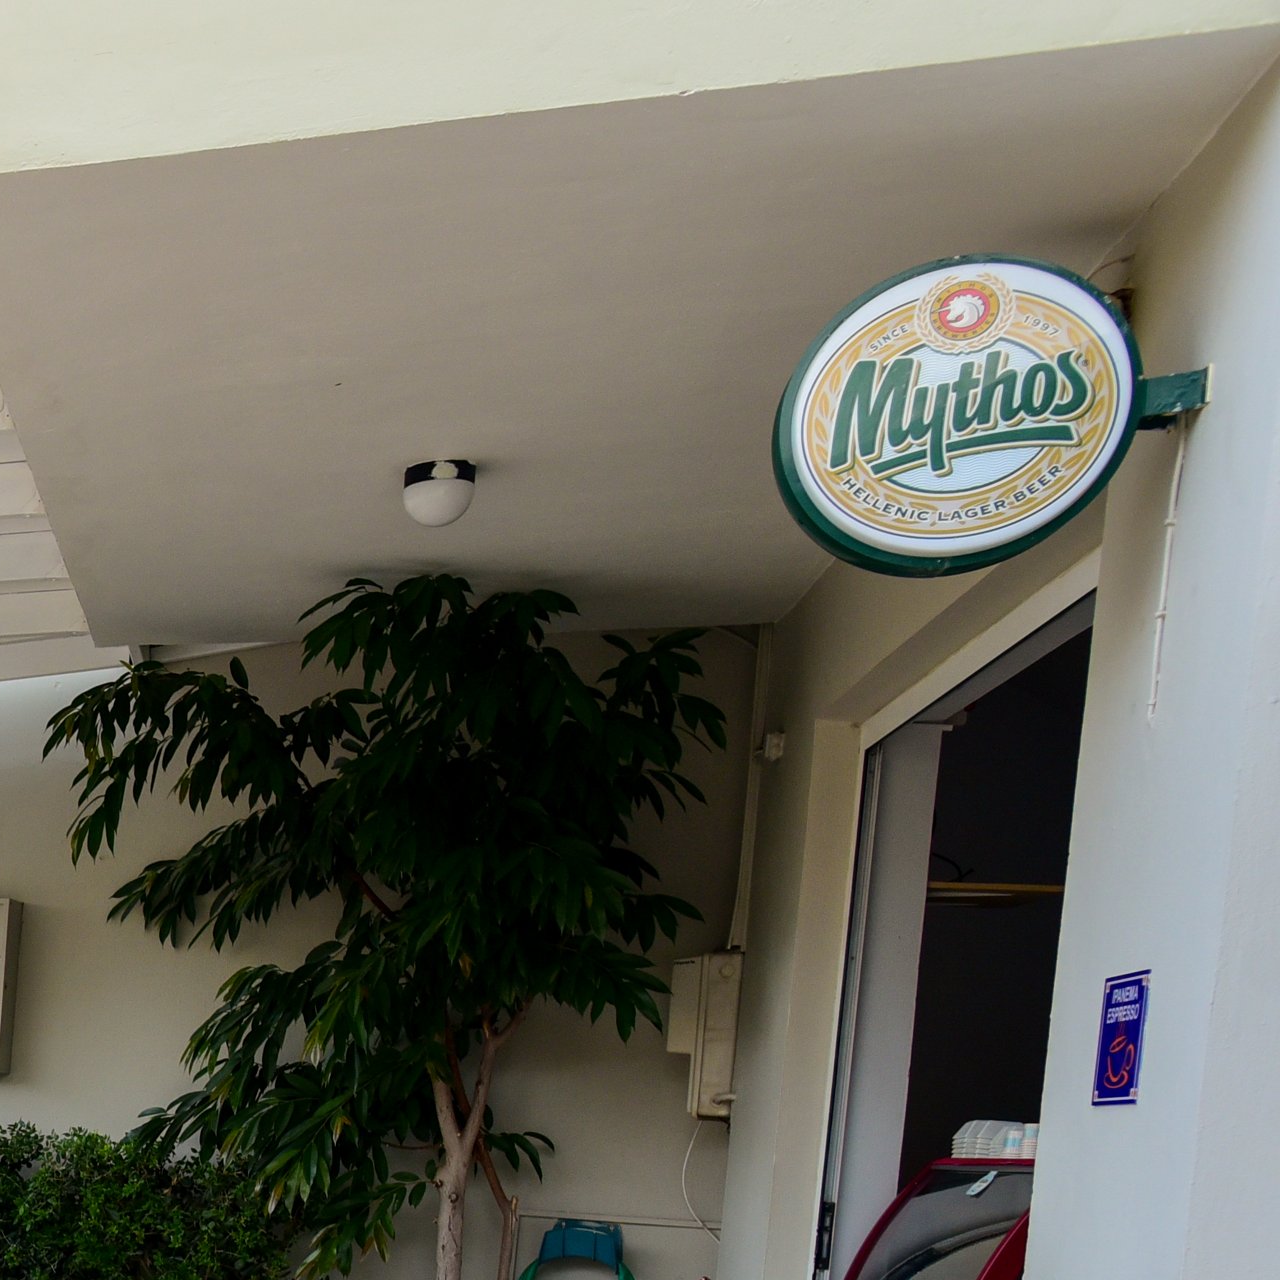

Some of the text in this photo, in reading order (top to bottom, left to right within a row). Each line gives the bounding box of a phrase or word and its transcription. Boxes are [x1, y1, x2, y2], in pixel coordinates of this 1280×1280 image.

[869, 314, 1060, 352] SINCE 1997
[828, 348, 1091, 474] Mythos
[842, 464, 1064, 523] HELLENIC LAGER BEER
[1106, 1003, 1140, 1024] ESPRESSO
[1111, 985, 1139, 1004] IPANEMA
